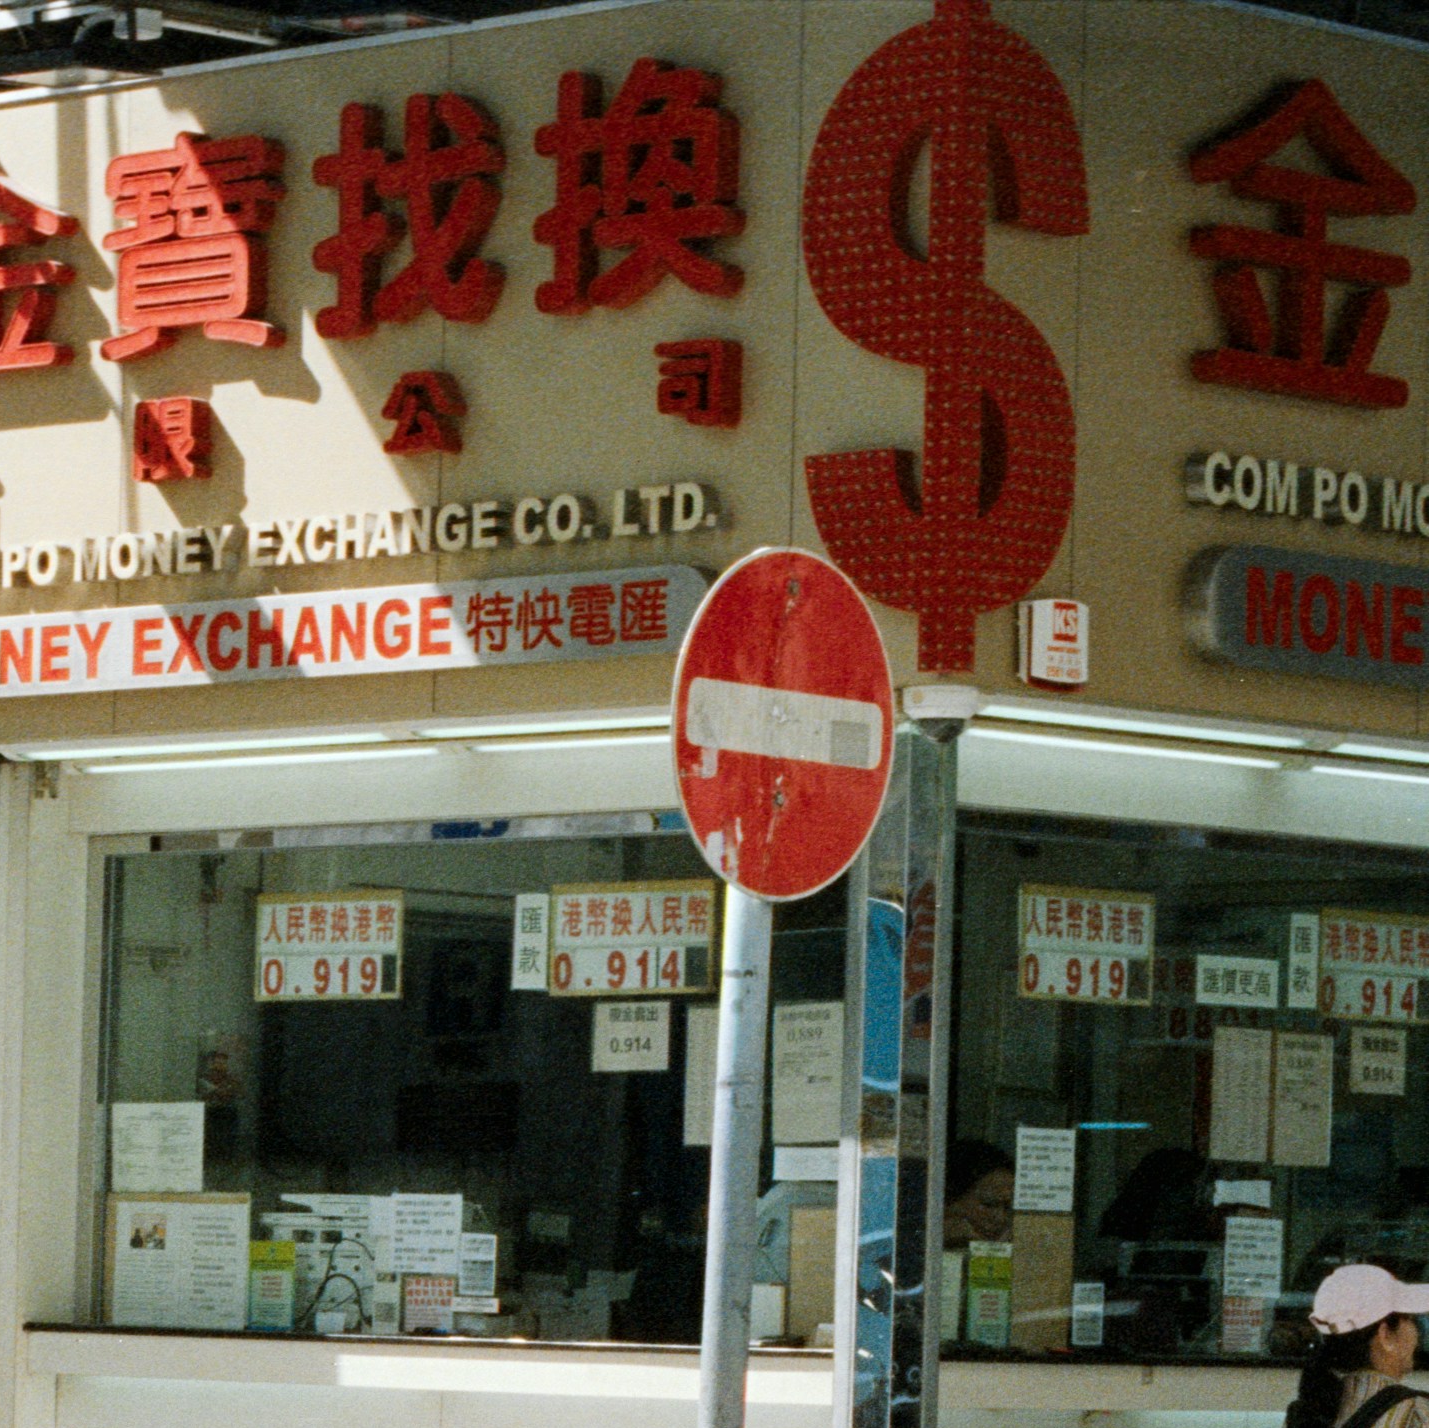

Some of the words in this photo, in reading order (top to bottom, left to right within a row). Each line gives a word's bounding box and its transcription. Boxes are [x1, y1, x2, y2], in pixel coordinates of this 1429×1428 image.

[1189, 77, 1417, 409] 金
[1204, 451, 1299, 516] COM
[1312, 467, 1369, 524] PO
[1, 545, 59, 588] PO
[73, 525, 233, 583] MONEY
[248, 501, 500, 567] EXCHANGE
[514, 495, 592, 544] CO.
[613, 482, 717, 537] LTD.
[132, 594, 453, 676] EXCHANGE
[465, 579, 669, 654] 特快電匯
[1245, 566, 1429, 666] MONE
[263, 904, 396, 944] 人民幣換港幣
[518, 906, 542, 974] 匯款
[562, 896, 710, 937] 港幣換人民幣
[1024, 896, 1145, 946] 人民幣換港幣
[263, 956, 378, 996] 0.919
[554, 949, 680, 990] 0.914
[1024, 953, 1125, 999] 0.919
[1320, 975, 1415, 1019] 0.914
